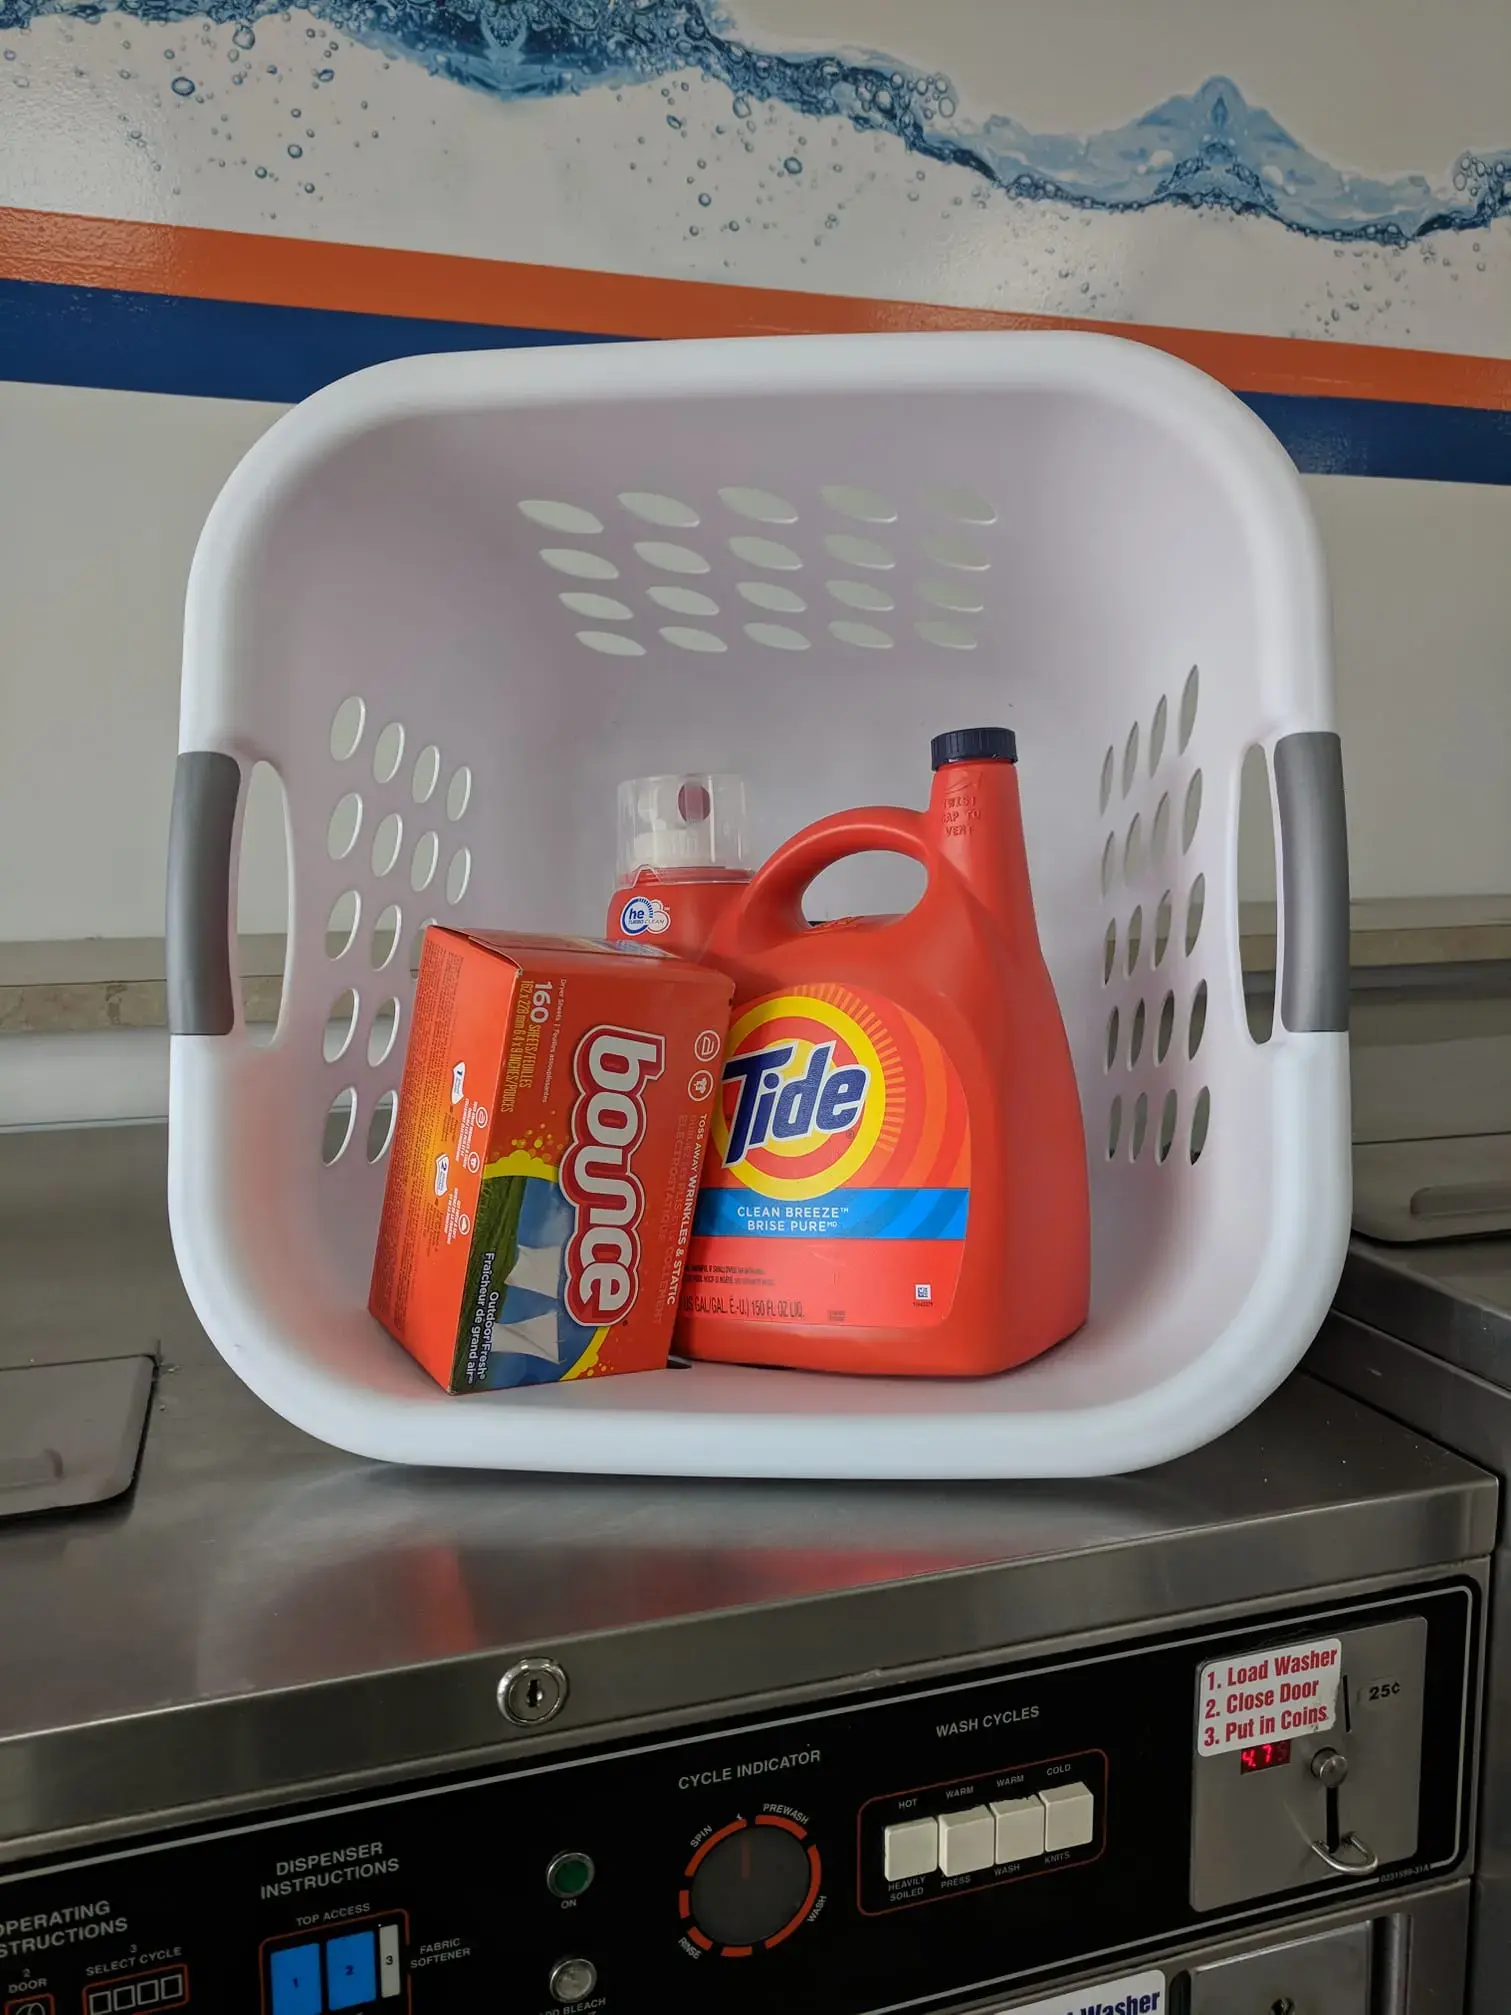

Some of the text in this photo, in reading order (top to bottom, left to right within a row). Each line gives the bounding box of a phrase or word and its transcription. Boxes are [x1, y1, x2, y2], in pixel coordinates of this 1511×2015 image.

[629, 908, 645, 920] he
[519, 981, 553, 1088] 160 SHEETS/FEUILLES
[500, 1054, 522, 1113] INCHES/POUCES
[722, 1042, 869, 1167] Tide
[575, 1034, 658, 1311] bounce
[667, 1113, 708, 1305] TOSS AWAY WRINKLES & STATIC
[737, 1206, 780, 1218] CLEAN
[747, 1221, 785, 1232] BRISE
[478, 1252, 495, 1306] Fraîcheur
[475, 1308, 487, 1324] de
[484, 1291, 499, 1341] Outdoor
[469, 1326, 481, 1359] grand
[1207, 1648, 1338, 1690] 1. Load Washer
[1205, 1680, 1319, 1719] 2. Close Door
[936, 1705, 1040, 1738] WASH CYCLES
[1204, 1706, 1328, 1747] 3. Put in Coins
[678, 1749, 820, 1790] CYCLE INDICATOR
[1046, 1764, 1071, 1776] COLD
[996, 1774, 1024, 1788] WARM
[946, 1785, 974, 1799] WARM
[763, 1803, 809, 1824] PREWASH
[898, 1798, 918, 1810] HOT
[690, 1824, 713, 1848] SPIN
[276, 1841, 383, 1876] DISPENSER
[1044, 1851, 1070, 1864] KNITS
[260, 1858, 400, 1900] INSTRUCTIONS
[994, 1863, 1020, 1876] WASH
[888, 1877, 925, 1891] HEAVILY
[940, 1875, 970, 1889] PRESS
[561, 1899, 576, 1909] ON
[890, 1887, 924, 1902] SOILED
[296, 1903, 370, 1926] TOP ACCESS
[807, 1895, 827, 1922] WASH
[130, 1944, 137, 1953] 3
[420, 1938, 460, 1954] FABRIC
[678, 1937, 701, 1959] RINSE
[86, 1947, 182, 1976] SELECT CYCLE
[410, 1948, 470, 1968] SOFTENER
[24, 1969, 31, 1978] 2
[292, 1955, 394, 1989] 1 2 3
[9, 1978, 47, 1993] DOOR
[563, 1998, 607, 2015] BLEACH
